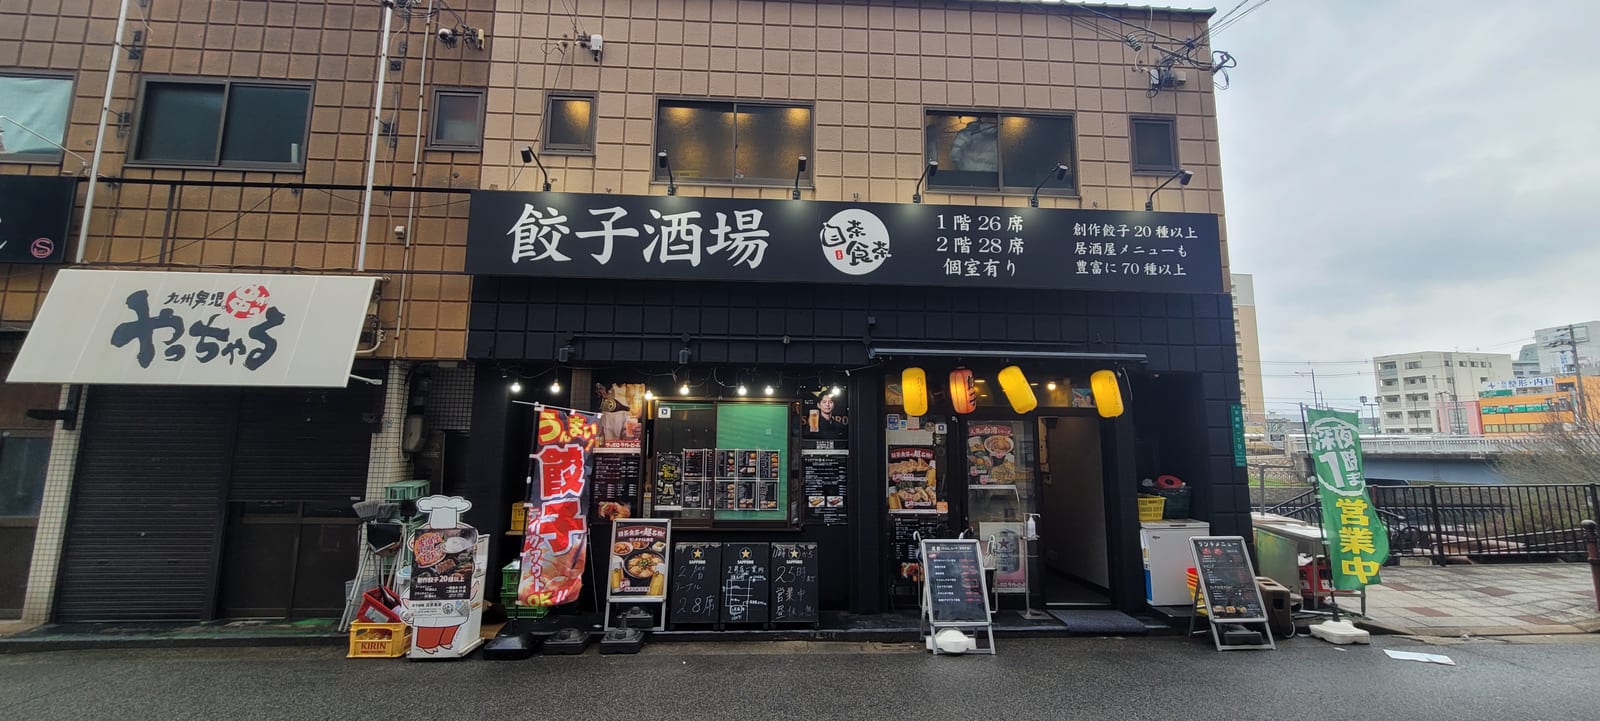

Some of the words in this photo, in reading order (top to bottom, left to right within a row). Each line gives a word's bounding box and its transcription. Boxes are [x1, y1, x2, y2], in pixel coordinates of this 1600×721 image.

[506, 203, 770, 269] 餃子酒場
[1074, 241, 1187, 257] 居酒屋メニューも
[943, 258, 1016, 277] 個室有り
[111, 289, 286, 371] やっちゃる
[1313, 426, 1355, 451] 深夜
[540, 444, 587, 556] 餃子
[528, 507, 545, 593] テイクアウト
[1336, 498, 1380, 584] 営業中
[676, 595, 715, 616] 28席
[775, 586, 806, 603] 営業中
[361, 642, 386, 650] KIRIN
